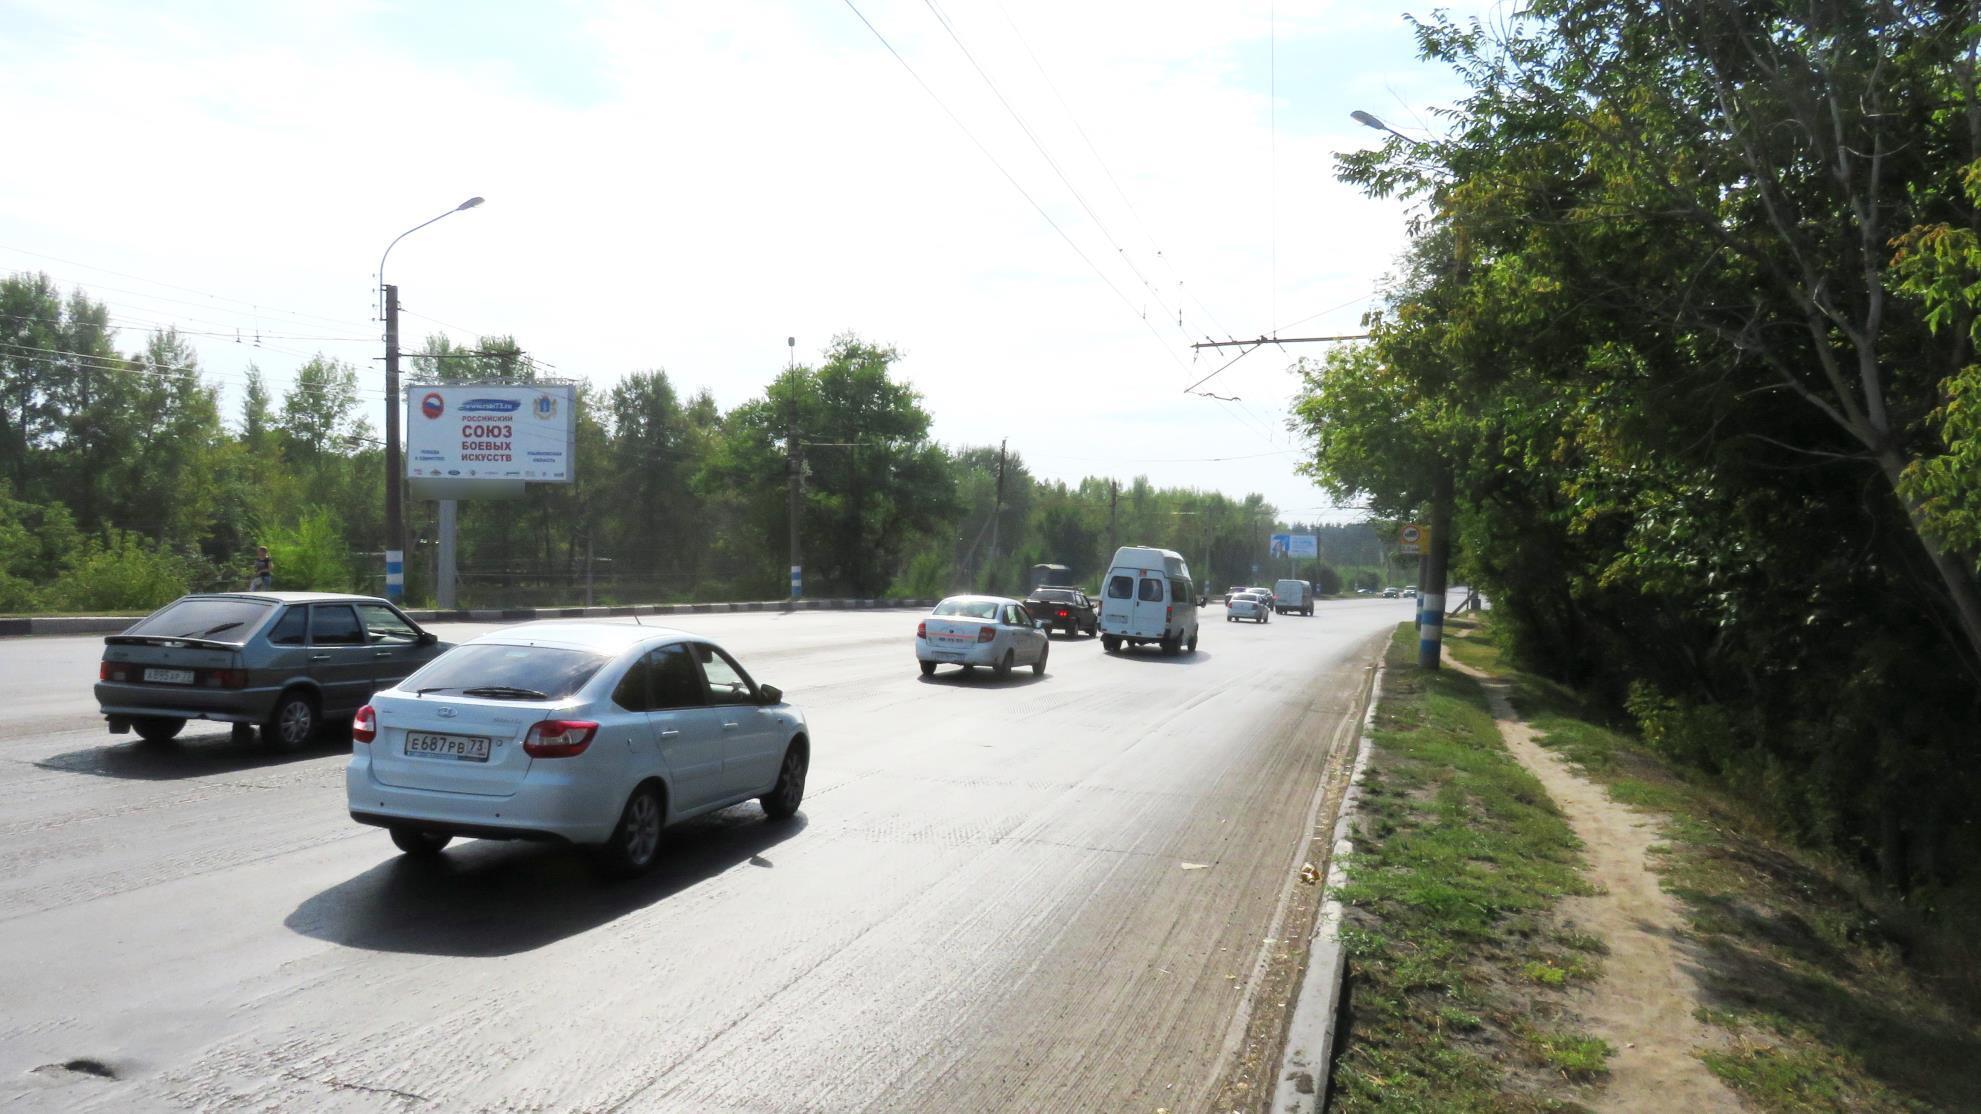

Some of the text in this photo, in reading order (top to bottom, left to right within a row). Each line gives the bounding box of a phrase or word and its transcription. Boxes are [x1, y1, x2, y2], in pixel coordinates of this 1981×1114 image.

[462, 425, 513, 438] СОЮЗ
[462, 441, 512, 451] БОЕВЫХ
[461, 453, 513, 462] ИСКУССТВ
[470, 739, 485, 751] 73
